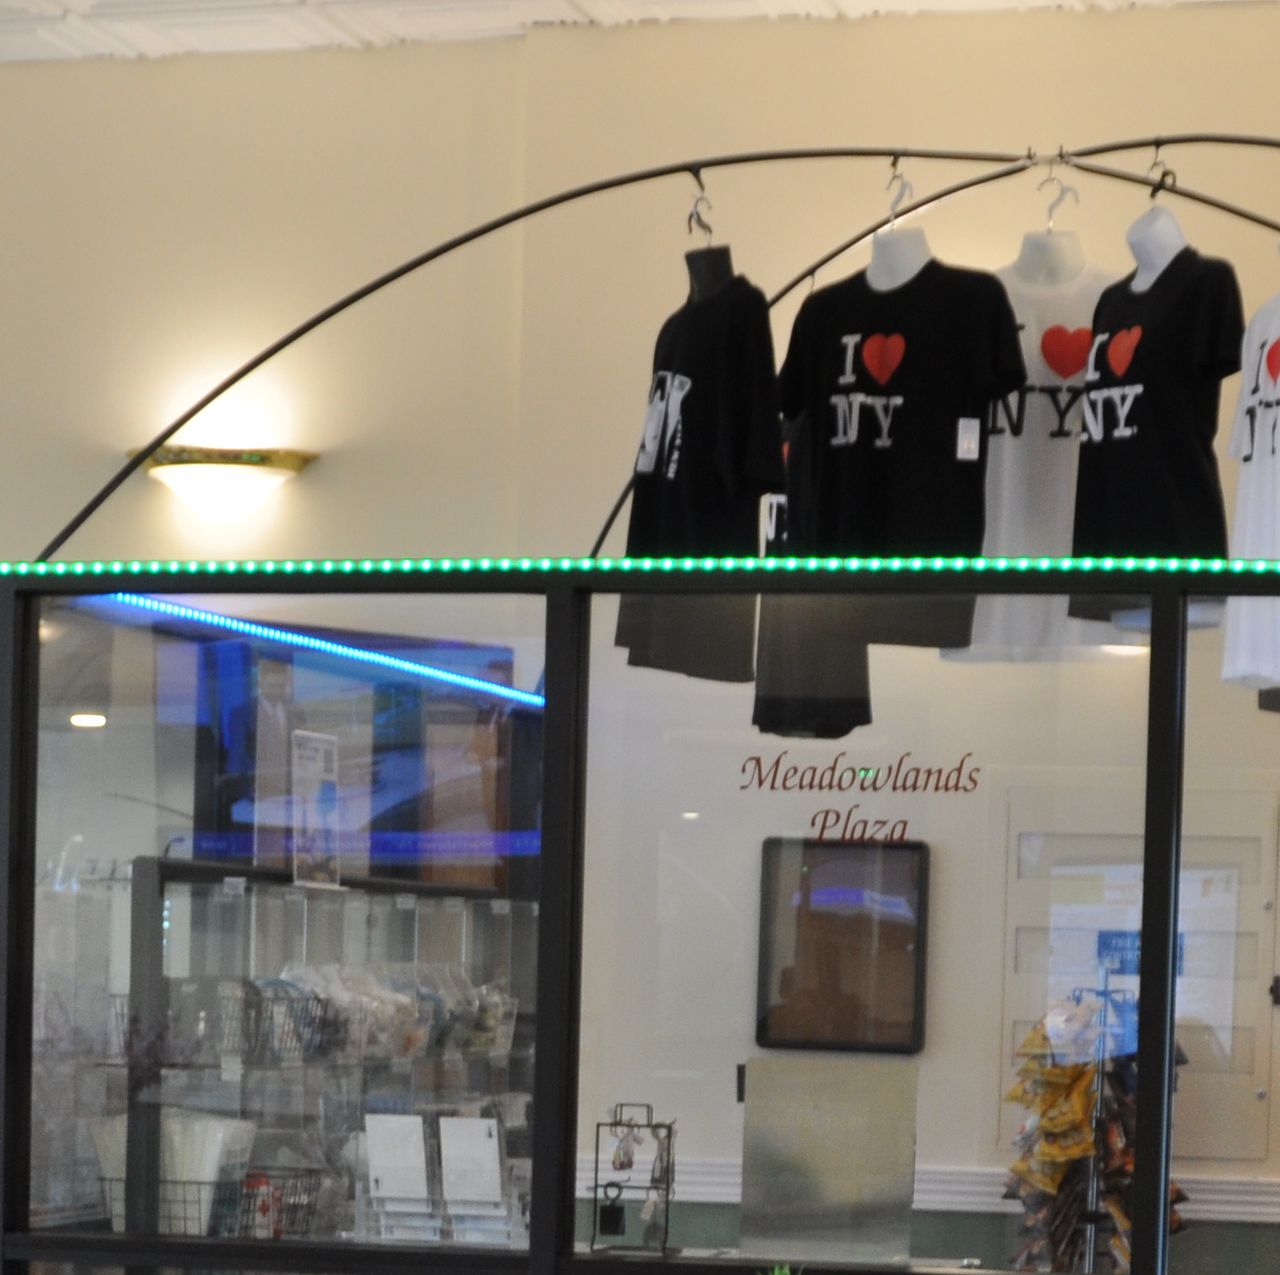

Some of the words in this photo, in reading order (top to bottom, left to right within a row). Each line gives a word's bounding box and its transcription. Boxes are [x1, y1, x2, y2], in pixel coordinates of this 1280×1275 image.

[837, 332, 862, 387] I
[1085, 331, 1110, 382] I
[829, 391, 905, 449] NY
[739, 750, 983, 793] Meadowlands
[810, 803, 911, 844] Plaza
